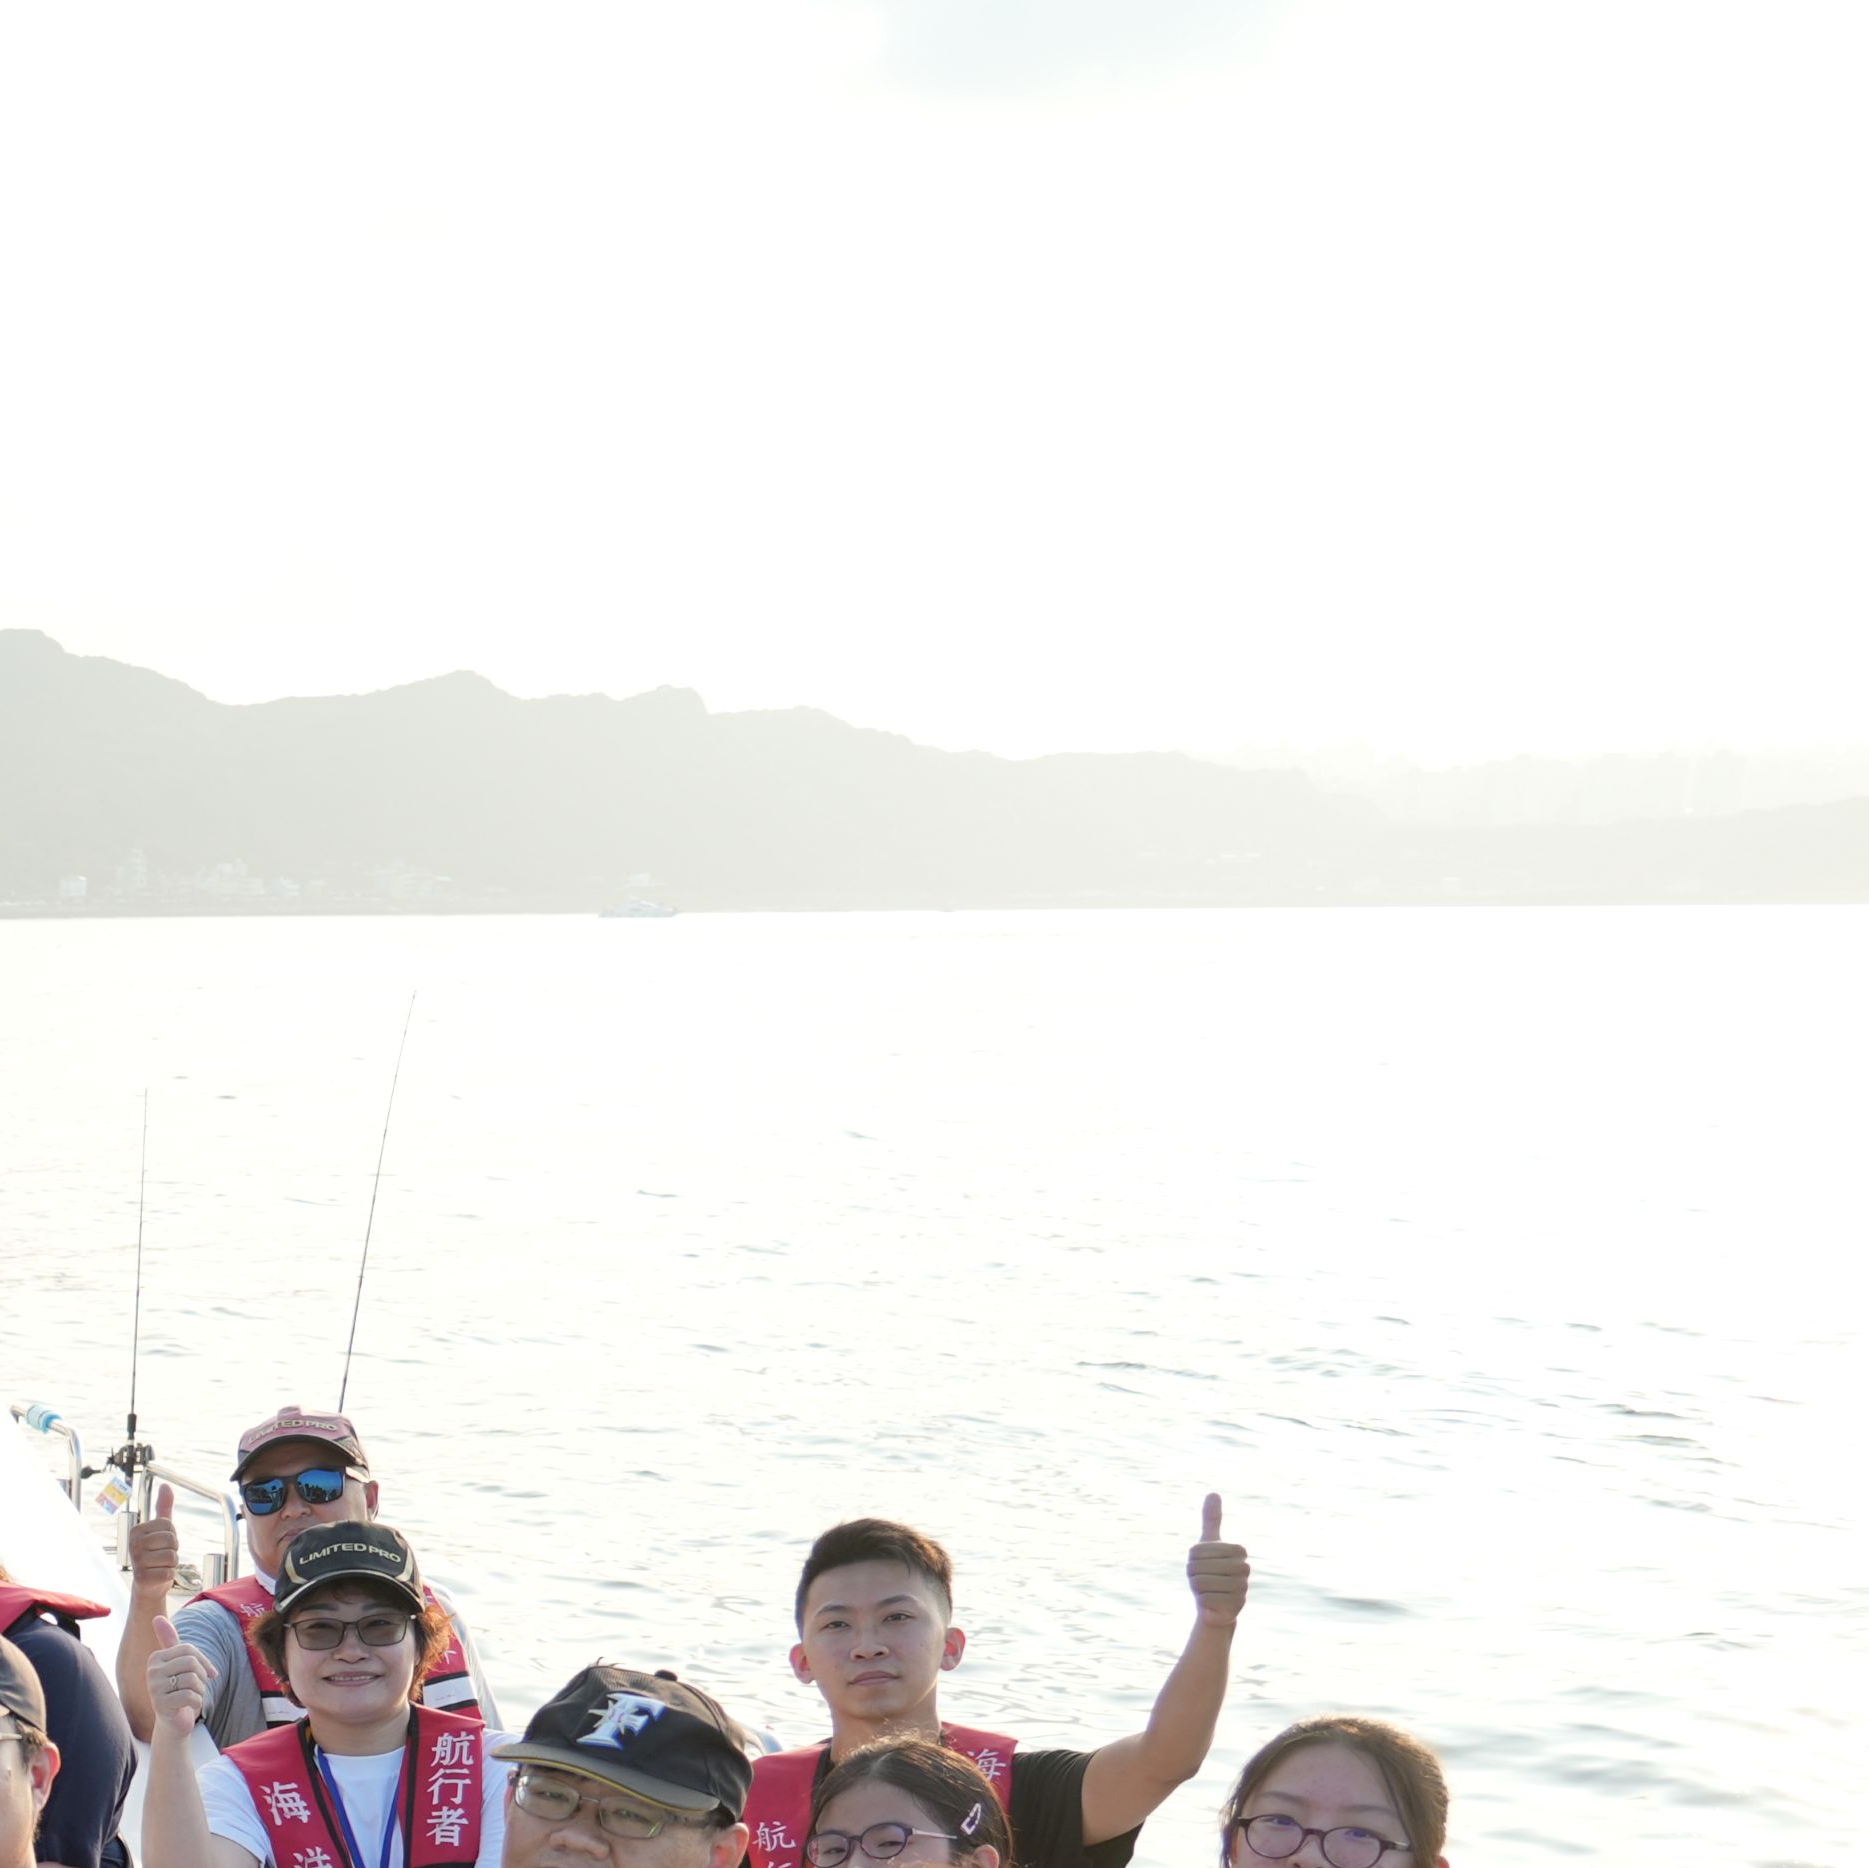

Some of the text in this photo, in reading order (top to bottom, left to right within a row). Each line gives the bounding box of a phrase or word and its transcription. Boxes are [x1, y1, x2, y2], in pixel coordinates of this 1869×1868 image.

[306, 1420, 338, 1431] PRO
[298, 1542, 402, 1565] LIMITED PRO
[426, 1731, 474, 1848] 航行者
